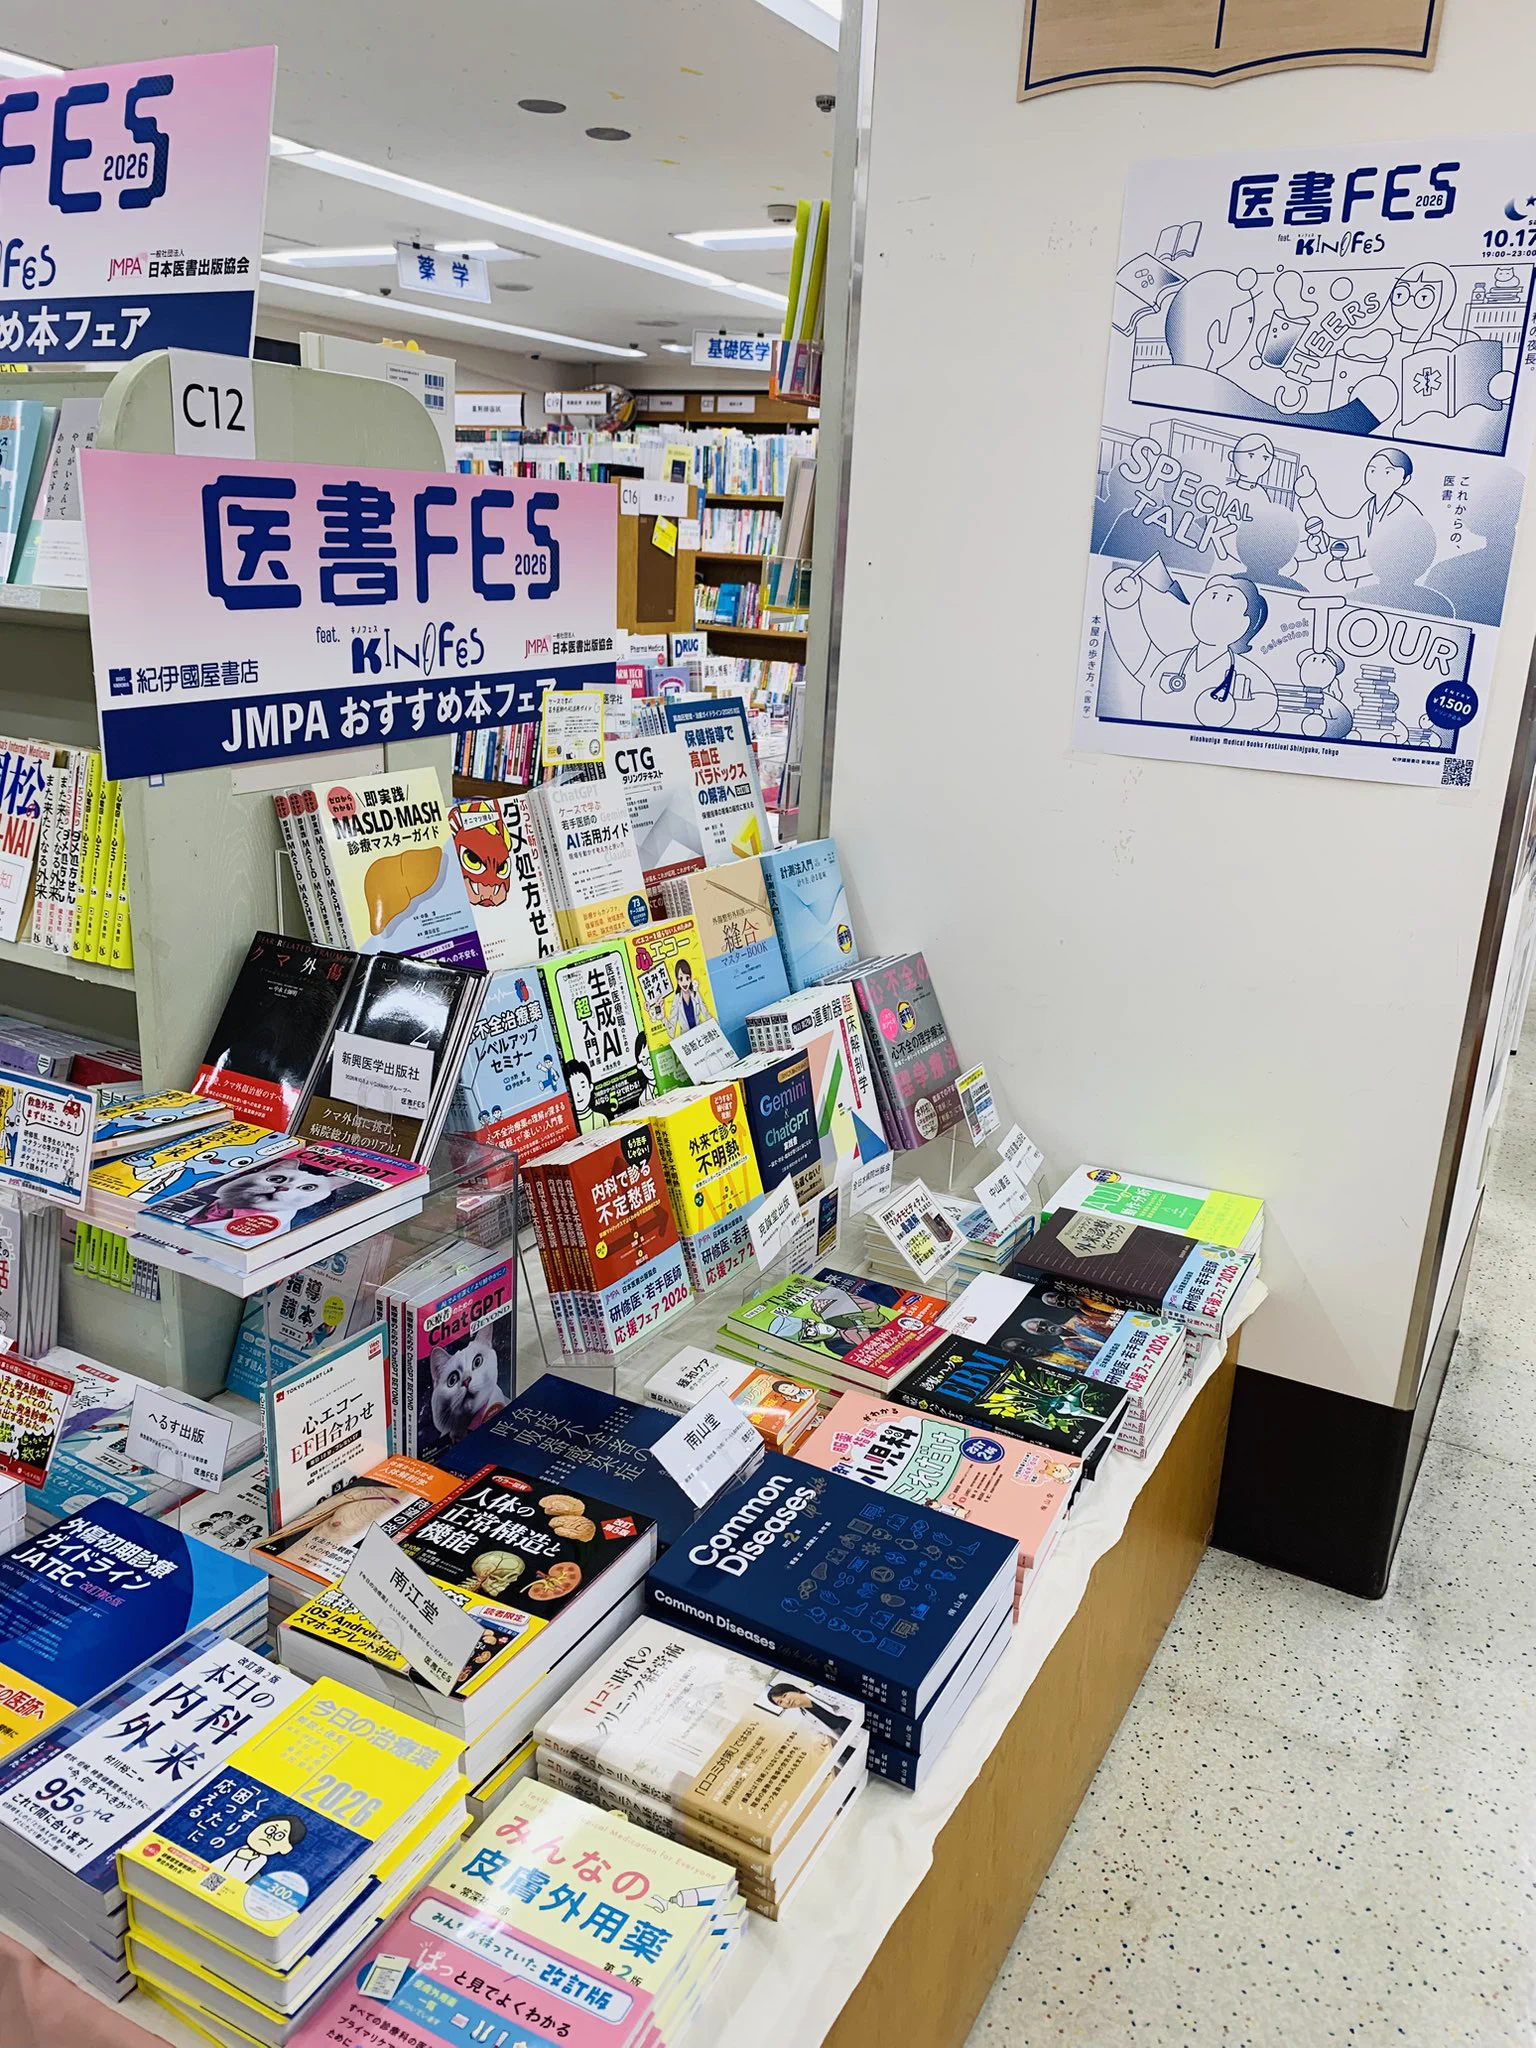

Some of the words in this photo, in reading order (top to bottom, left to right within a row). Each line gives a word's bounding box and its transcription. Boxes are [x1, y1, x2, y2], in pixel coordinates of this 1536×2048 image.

[103, 152, 149, 181] 2026
[1228, 162, 1460, 229] 医書FES
[1415, 194, 1443, 208] 2026
[108, 257, 145, 281] JMPA
[148, 256, 250, 278] 日本医書出版協会
[707, 338, 770, 362] 基礎医学
[1274, 292, 1380, 415] CHEERS
[183, 384, 246, 432] C12
[1119, 437, 1253, 522] SPECIAL
[622, 489, 638, 505] C16
[1131, 491, 1240, 561] TALK
[202, 475, 559, 611] 医書FES
[514, 553, 547, 576] 2026
[316, 624, 341, 645] feat.
[1280, 618, 1309, 633] Book
[1298, 596, 1459, 675] TOUR
[524, 636, 549, 660] JMPA
[552, 637, 613, 656] 日本医書出版協会
[675, 639, 699, 658] DRUG
[1260, 629, 1310, 656] Selection
[136, 660, 259, 692] 紀伊國屋書店
[221, 702, 327, 753] JMPA
[685, 725, 734, 748] 保健指導で
[1222, 737, 1245, 748] Medical
[1246, 739, 1264, 750] Books
[28, 743, 51, 760] Medicine
[615, 747, 655, 774] CTG
[689, 747, 720, 769] 高血圧
[695, 763, 748, 786] パラドックス
[329, 793, 353, 805] ゼロから
[364, 786, 406, 807] 即実践
[559, 801, 602, 818] ケースで学ぶ
[698, 786, 736, 806] の解消へ
[34, 775, 54, 900] また来たくなる外来
[519, 799, 540, 861] ぶった斬り
[561, 815, 598, 831] 若手医師の
[566, 823, 630, 851] AI活用ガイド
[347, 825, 440, 856] 診療マスターガイド
[502, 798, 555, 959] ダメ処方せん
[779, 858, 814, 880] 計測法入門
[632, 899, 641, 908] 73
[766, 873, 780, 914] 計測法入門
[721, 918, 760, 951] 縫合
[251, 944, 342, 982] クマ外傷
[636, 937, 691, 971] 心エコー
[721, 943, 769, 967] マスターBOOK
[641, 968, 667, 990] 読み方
[647, 979, 671, 1001] ガイド
[588, 968, 623, 1062] 生成AI
[812, 997, 843, 1028] 運動器
[474, 1026, 538, 1062] レベルアップ
[681, 1028, 720, 1057] 診断と治療社
[891, 1021, 945, 1060] 心不全の理学療法
[342, 1051, 420, 1082] 新興医学出版社
[490, 1051, 534, 1075] セミナー
[27, 1096, 57, 1113] 救急外来、
[760, 1075, 807, 1117] Gemini
[323, 1107, 397, 1138] クマ外傷に挑む、
[765, 1108, 810, 1147] ChatGPT
[626, 1136, 648, 1152] もう苦手
[688, 1120, 738, 1159] 外来で診る
[296, 1150, 398, 1180] ChatGPT
[696, 1140, 741, 1177] 不明熱
[590, 1159, 652, 1203] 内科で診る
[988, 1175, 1012, 1197] 中山書店
[597, 1178, 657, 1228] 不定愁訴
[758, 1194, 791, 1238] 克誠堂出版
[1119, 1187, 1153, 1217] 動作分析
[712, 1215, 744, 1239] 日本医書出版協会
[1074, 1219, 1113, 1253] 外来診療
[1101, 1225, 1127, 1252] ガイドブック
[621, 1267, 657, 1294] 日本医書出版協会
[706, 1247, 745, 1286] 応援フェア
[608, 1264, 683, 1324] 研修医・若手医師
[766, 1283, 805, 1306] That's
[771, 1287, 821, 1318] 形成外科
[1181, 1260, 1220, 1312] 研修医・若手医師
[1201, 1281, 1229, 1319] 応援フェア
[1219, 1264, 1239, 1284] 2026
[428, 1287, 505, 1347] ChatGPT
[471, 1305, 511, 1333] BEYOND
[613, 1298, 660, 1346] 応援フェア
[661, 1284, 688, 1314] 2026
[406, 1351, 414, 1381] ChatGPT
[676, 1358, 710, 1389] 緩和ケア
[1104, 1329, 1150, 1386] 研修医・若手医師
[1125, 1355, 1155, 1393] 応援フェア
[1147, 1334, 1170, 1358] 2026
[286, 1382, 305, 1396] TOKYO
[305, 1373, 323, 1387] HEART
[323, 1366, 334, 1377] LAB
[391, 1377, 399, 1406] BEYOND
[937, 1349, 1010, 1404] EBM
[148, 1412, 206, 1445] へるす出版
[302, 1392, 364, 1436] 心エコー
[291, 1401, 375, 1465] EF目合わせ
[511, 1407, 651, 1463] 免疫不全者の
[683, 1413, 721, 1451] 南山堂
[489, 1420, 647, 1483] 呼吸器感染症
[856, 1425, 919, 1485] 小児科
[893, 1431, 961, 1503] これだけ
[460, 1488, 536, 1518] 人体の
[437, 1503, 561, 1558] 正常構造と
[603, 1524, 633, 1538] 第5版
[613, 1518, 634, 1530] 改訂
[688, 1475, 793, 1566] Common
[716, 1487, 817, 1578] Diseases
[59, 1517, 179, 1579] 外傷初期診療
[415, 1520, 480, 1555] 機能
[11, 1547, 88, 1588] JATEC
[36, 1532, 152, 1590] ガイドライン
[389, 1566, 440, 1626] 南江堂
[483, 1606, 526, 1623] 読者限定
[654, 1588, 716, 1627] Common
[715, 1613, 776, 1652] Diseases
[200, 1663, 275, 1709] 本日の
[237, 1657, 282, 1685] 改訂第2版
[584, 1646, 652, 1714] 口コミ時代の
[595, 1642, 687, 1735] クリニック経営術
[149, 1681, 253, 1746] 内科
[102, 1712, 206, 1782] 外来
[310, 1699, 442, 1771] 今日の治療薬
[103, 1754, 138, 1779] 村川裕二
[34, 1777, 91, 1826] 95%
[188, 1778, 238, 1819] 応える
[299, 1774, 384, 1828] 2026
[209, 1797, 270, 1849] くすりの
[495, 1815, 650, 1903] みんなの
[266, 1882, 294, 1901] 300
[461, 1846, 673, 1966] 皮膚外用薬
[538, 1962, 613, 2012] 改訂版
[604, 1959, 644, 1988] 第2版
[325, 2028, 353, 2048] ために
